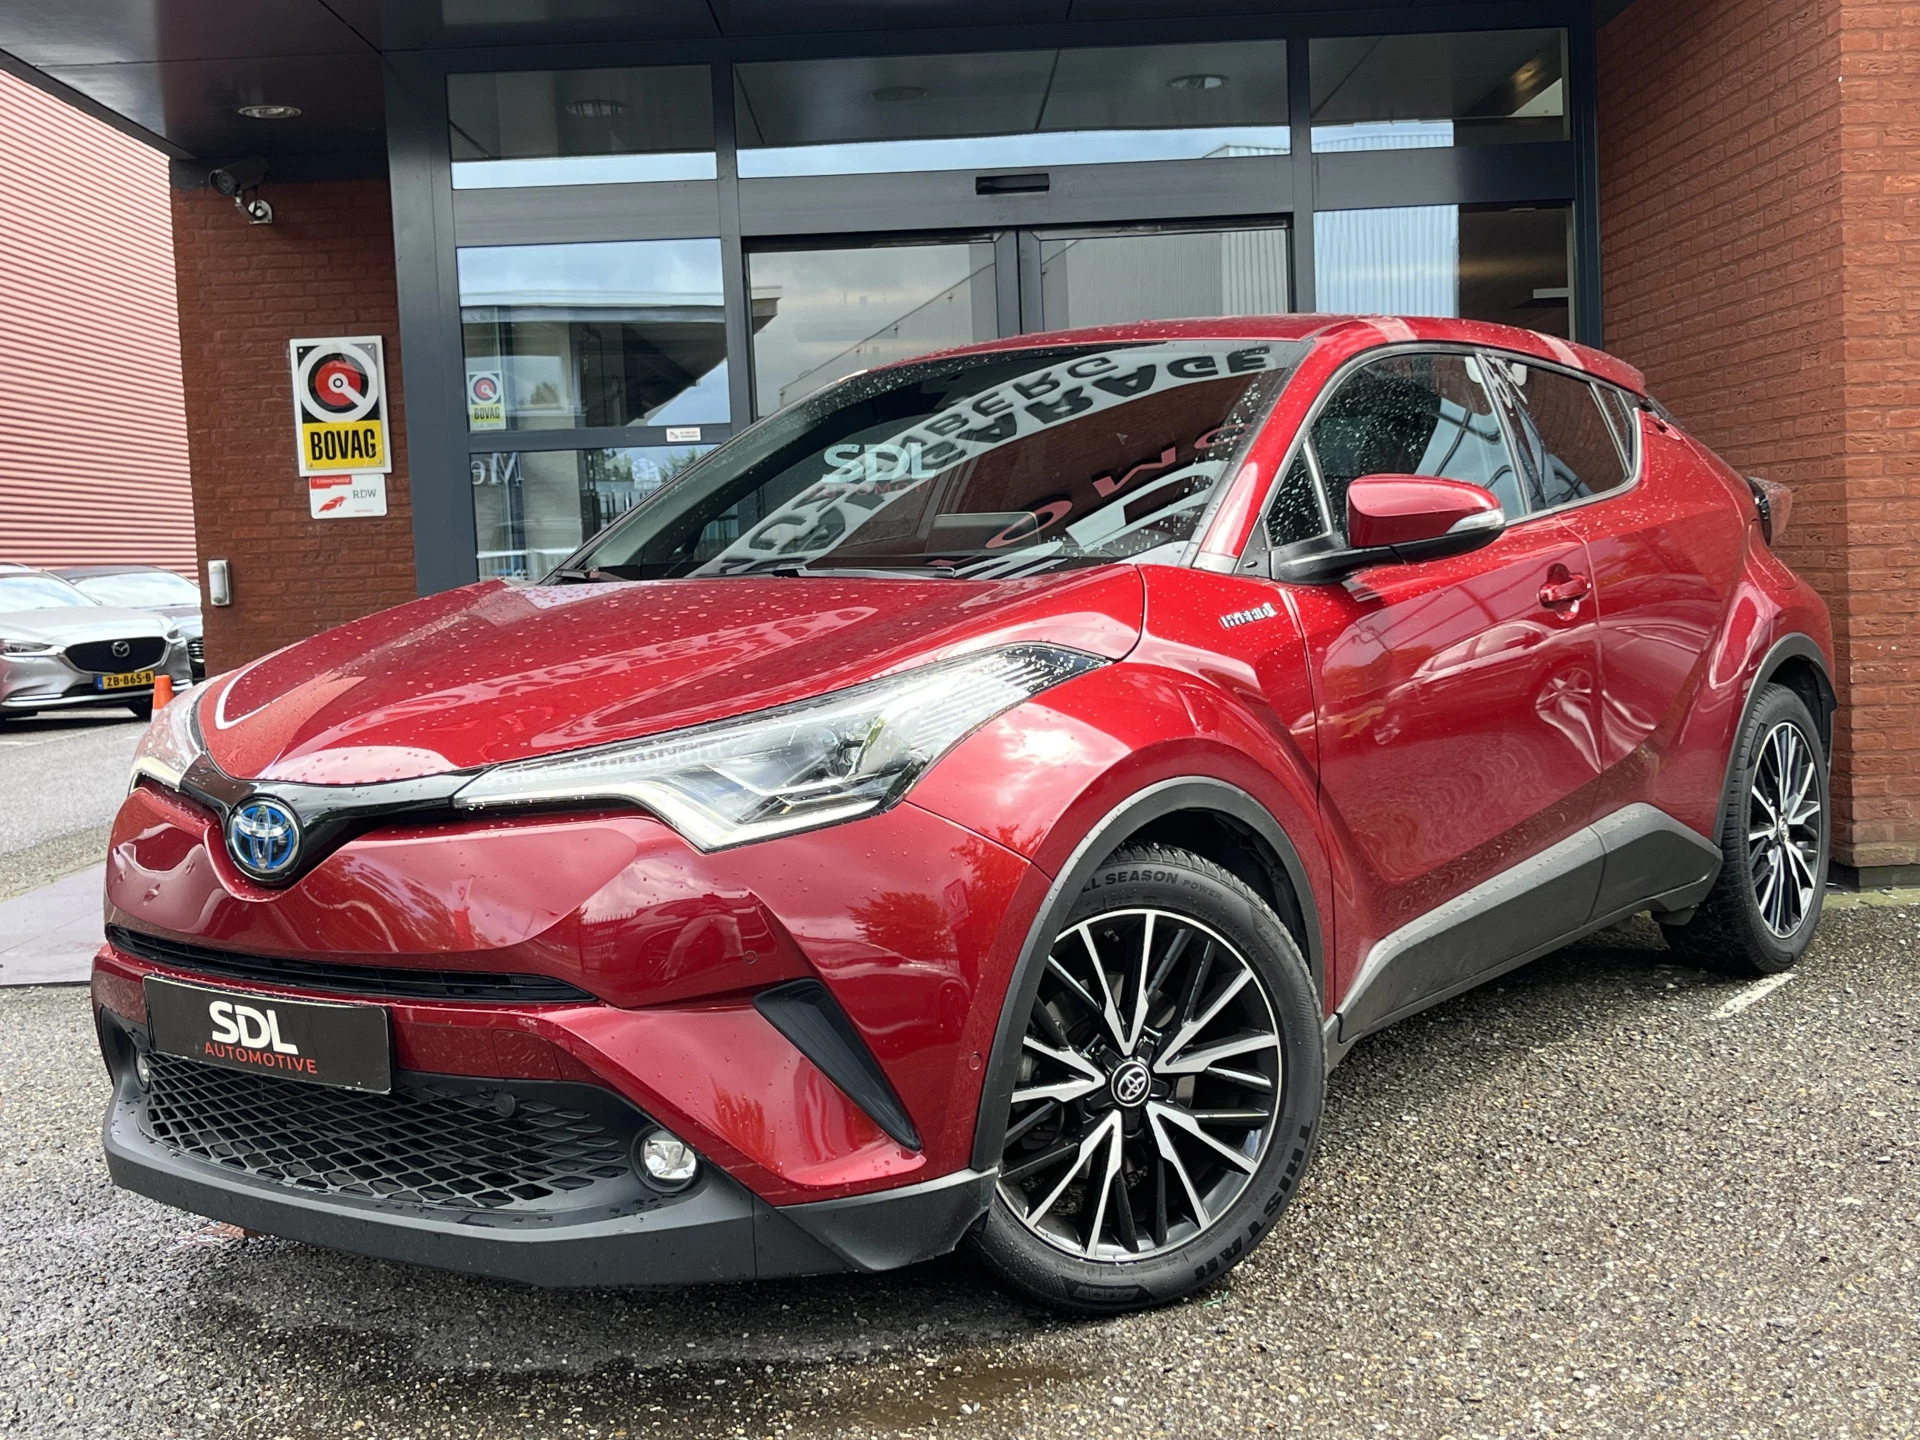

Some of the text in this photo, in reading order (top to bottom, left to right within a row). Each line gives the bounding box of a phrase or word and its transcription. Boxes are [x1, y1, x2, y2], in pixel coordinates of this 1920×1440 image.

[474, 406, 501, 420] BOVAG
[310, 428, 377, 461] BOVAG
[820, 441, 936, 484] SDL
[352, 489, 377, 499] RDW
[106, 672, 152, 687] ZB-865-B
[1104, 870, 1179, 886] SEASON
[1182, 879, 1224, 902] POWER
[208, 1000, 299, 1055] SDL
[204, 1041, 318, 1075] AUTOMOTIVE
[1193, 1121, 1313, 1282] TRISTAR
